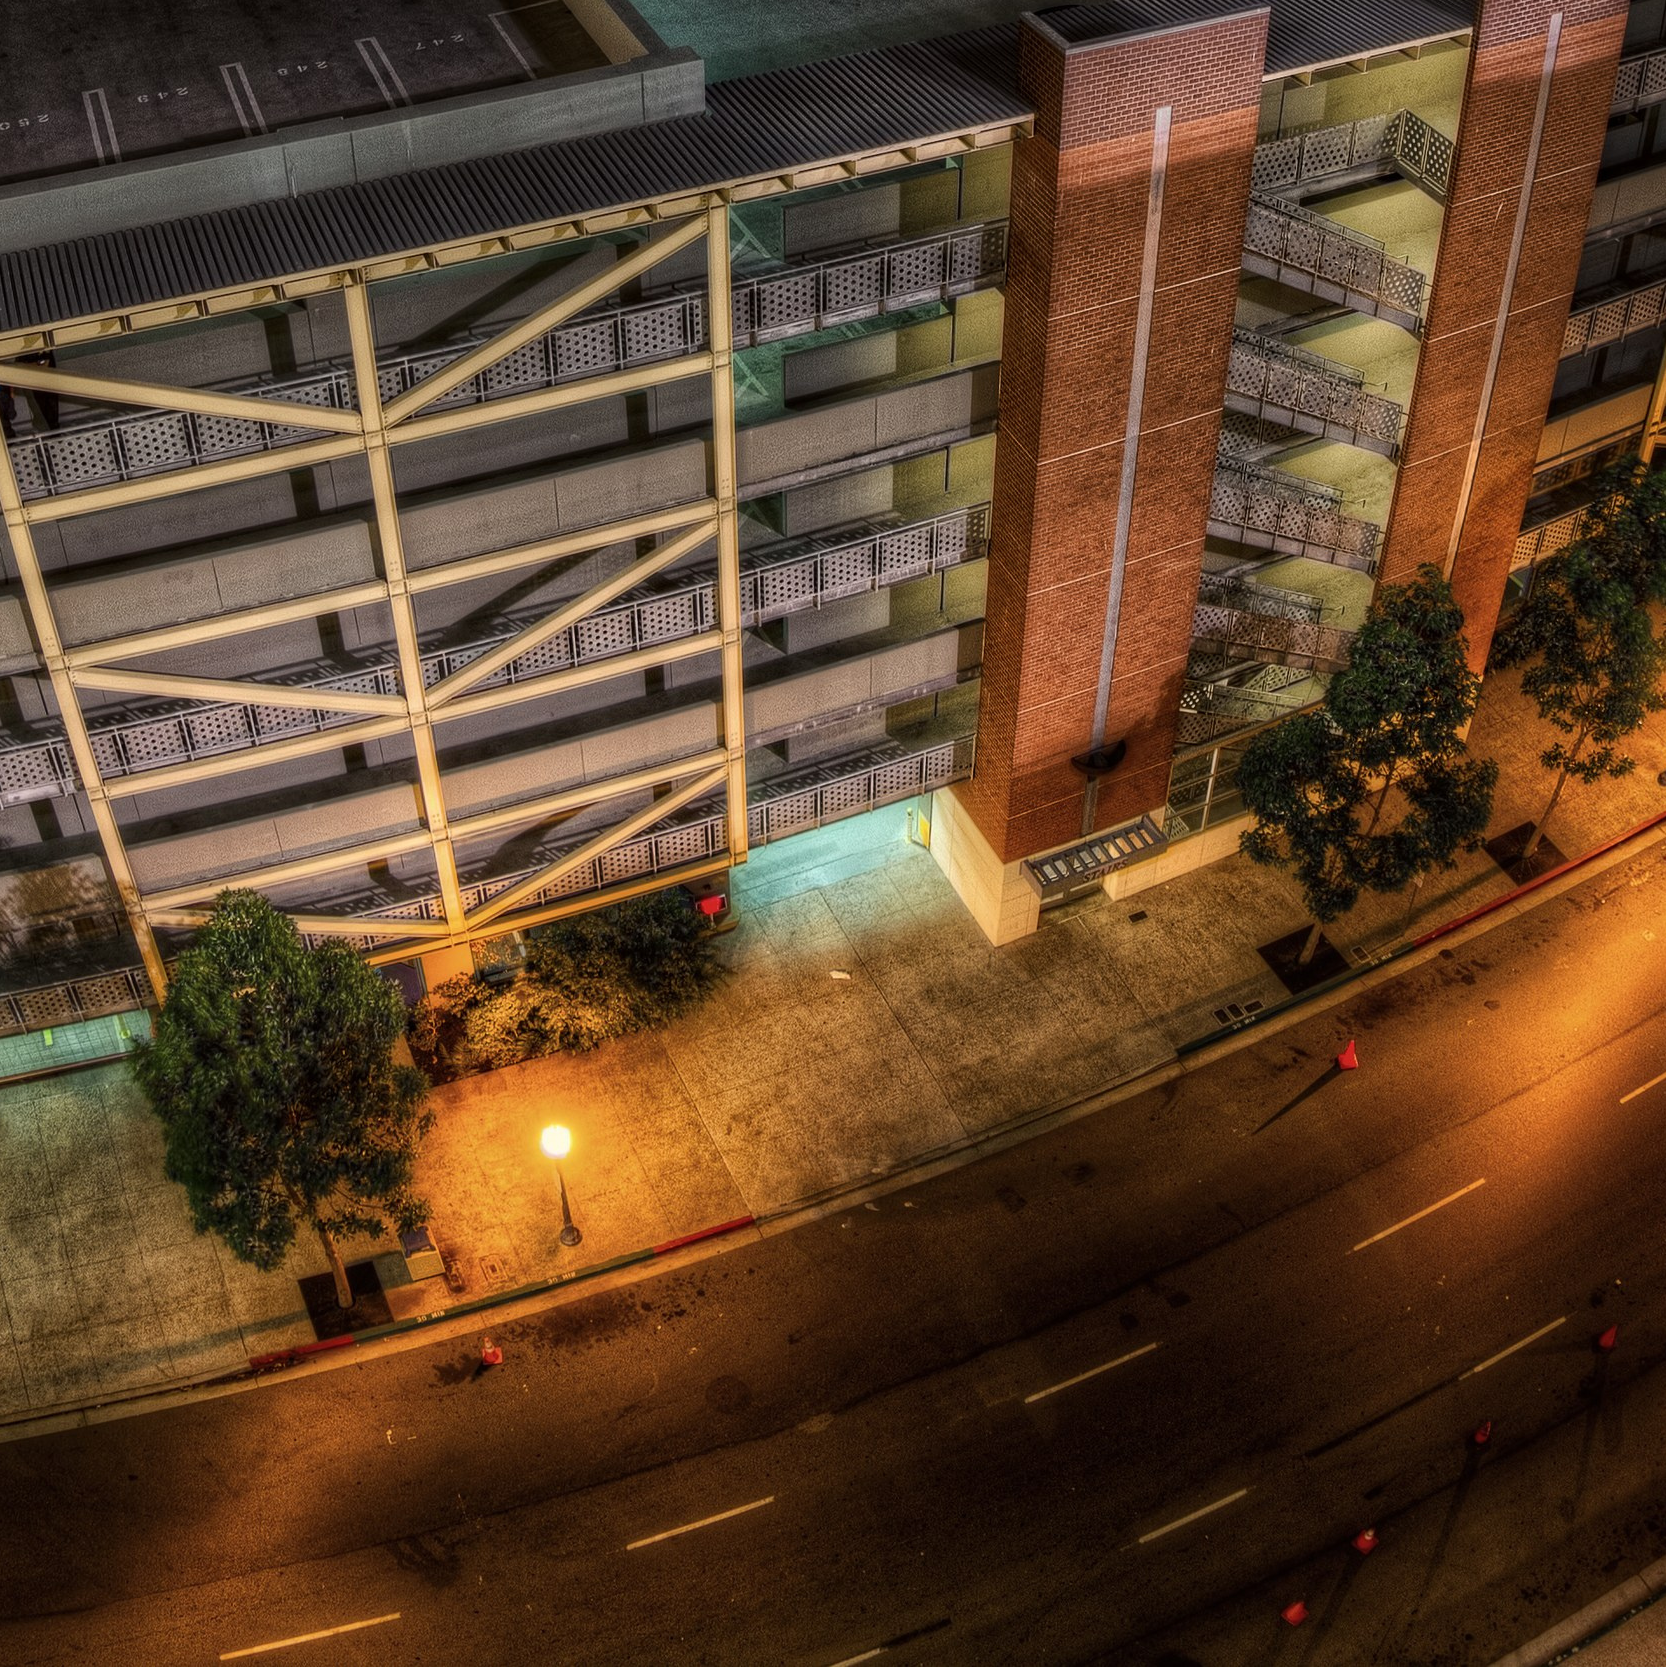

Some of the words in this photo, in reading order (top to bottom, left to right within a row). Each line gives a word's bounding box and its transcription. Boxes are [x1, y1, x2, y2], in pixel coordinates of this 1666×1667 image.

[412, 33, 464, 51] 247
[275, 59, 328, 77] 248
[135, 85, 189, 104] 249
[1083, 857, 1129, 882] STAIRS
